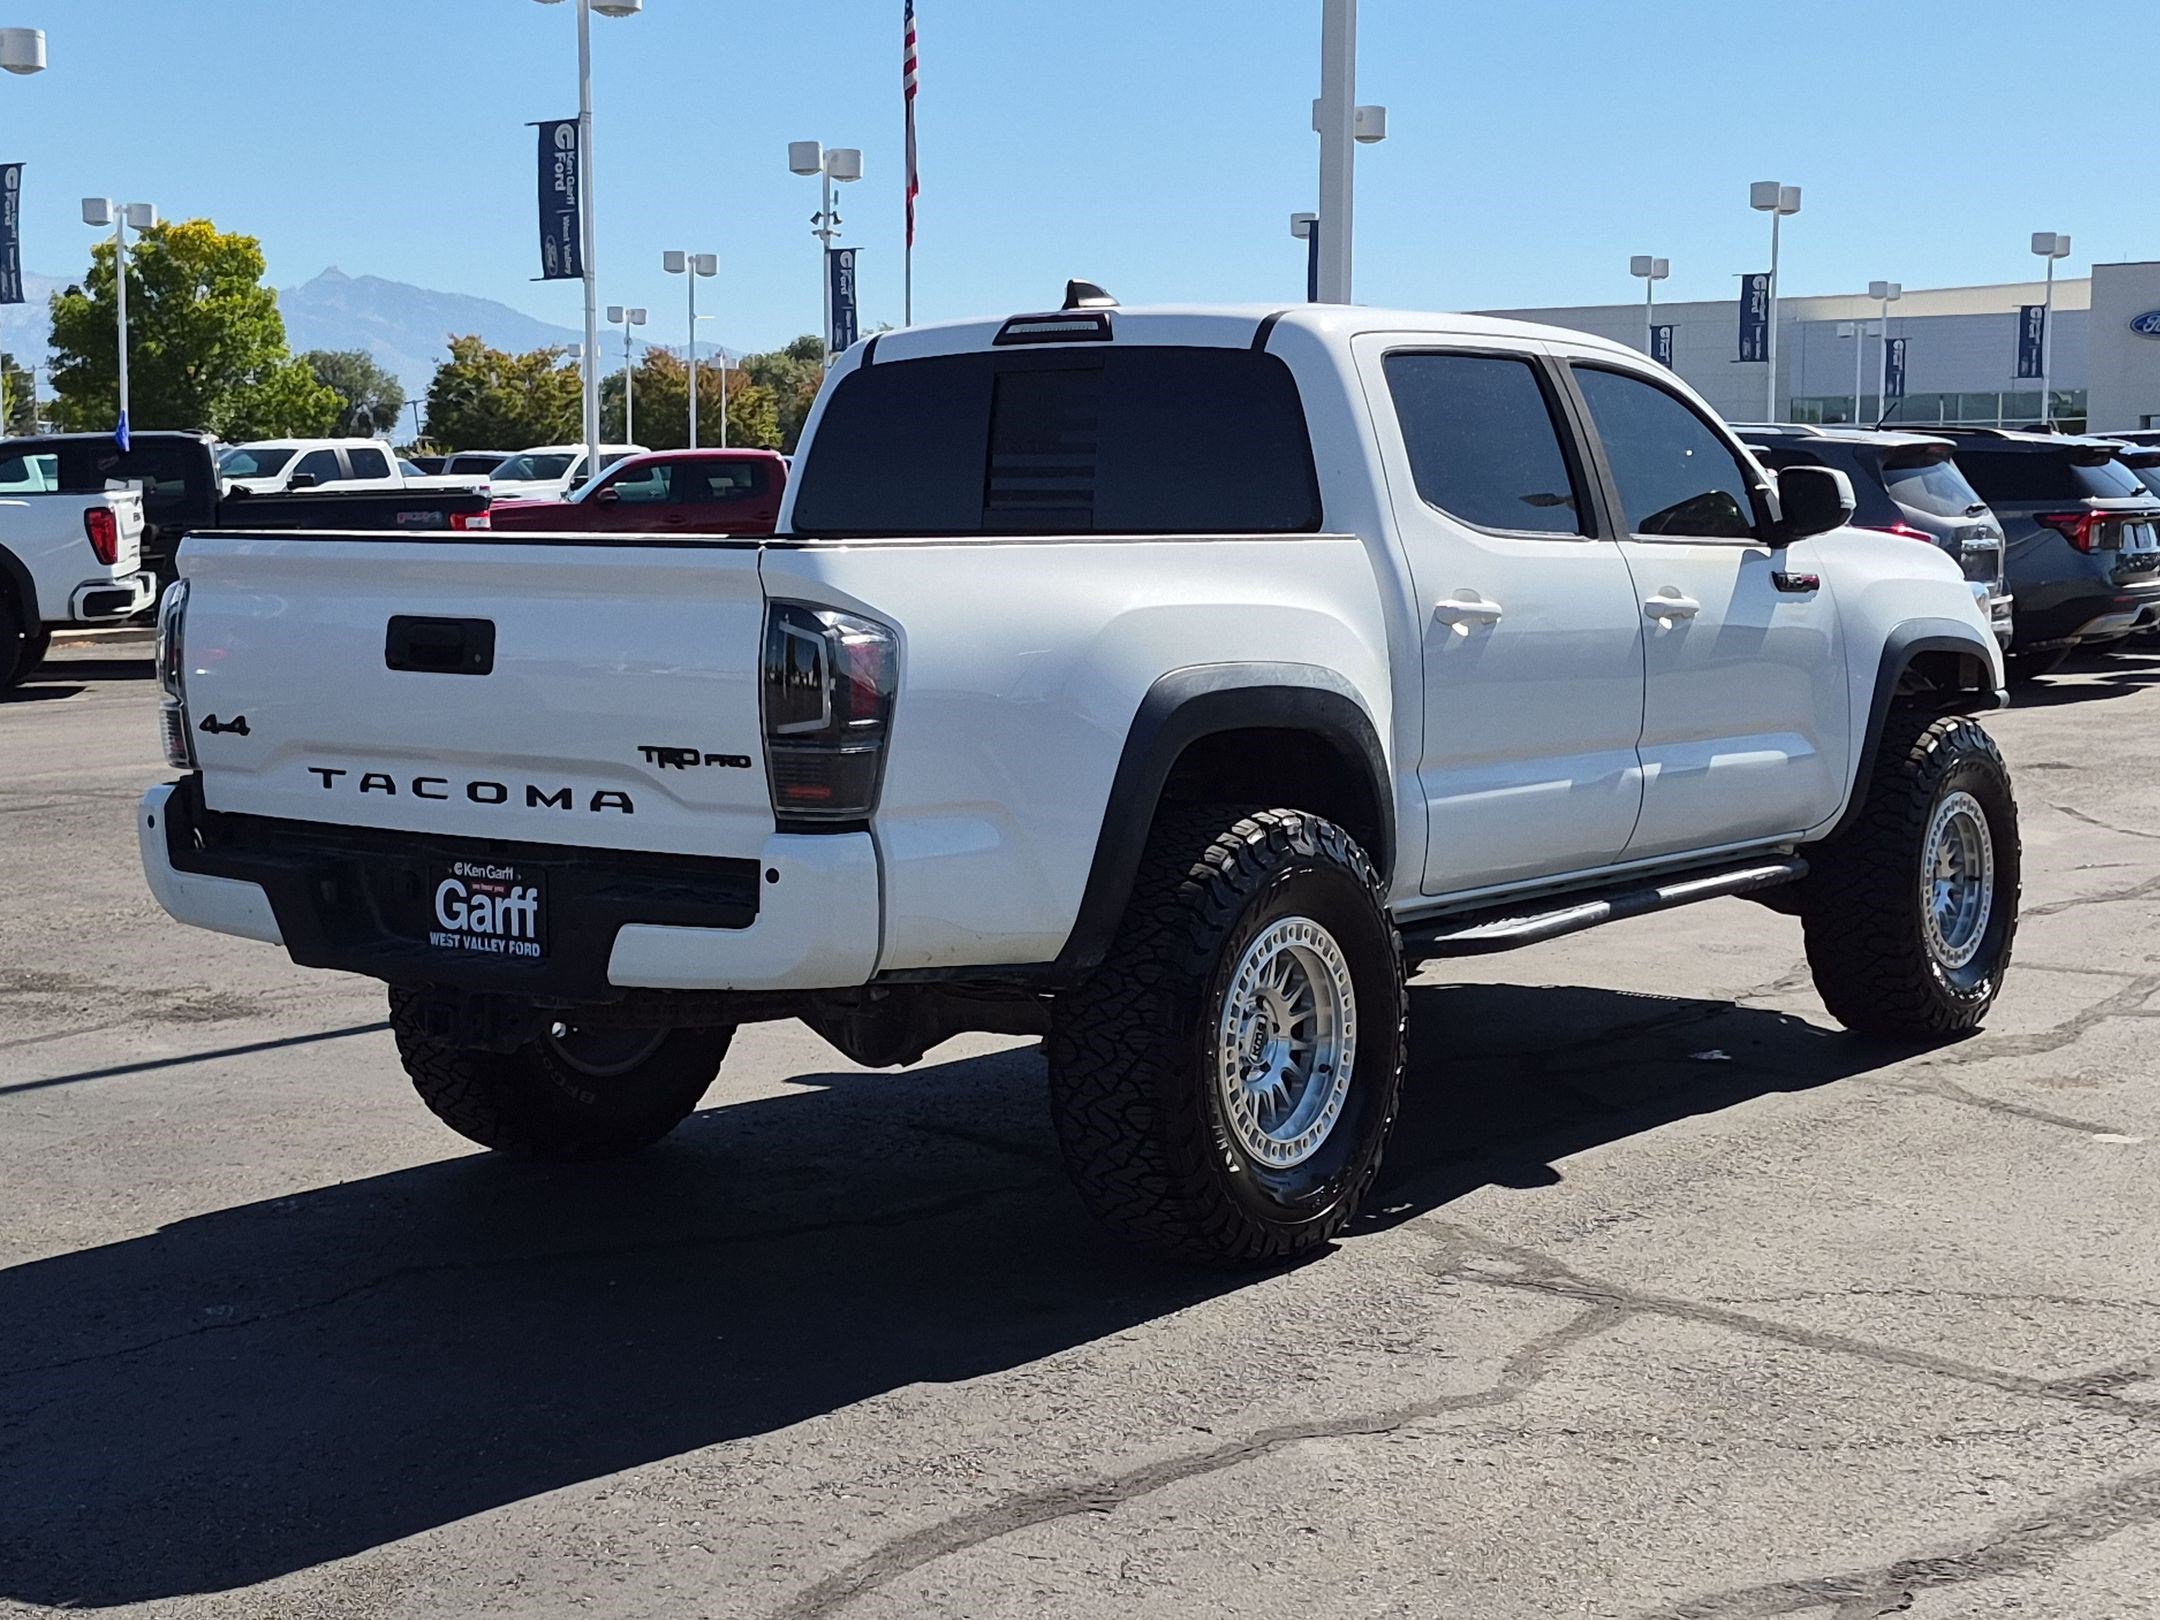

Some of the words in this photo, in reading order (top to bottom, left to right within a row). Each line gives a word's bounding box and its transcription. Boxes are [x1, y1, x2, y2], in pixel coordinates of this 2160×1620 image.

[555, 152, 566, 191] Ford
[566, 151, 576, 174] Ken
[637, 745, 701, 771] TRD
[704, 753, 752, 769] PRO
[308, 766, 635, 815] TACOMA
[463, 862, 485, 878] Ken
[486, 864, 514, 880] Garff
[435, 878, 538, 939] Garff
[429, 931, 461, 948] WEST
[463, 935, 506, 953] VALLEY
[509, 940, 541, 957] FORD
